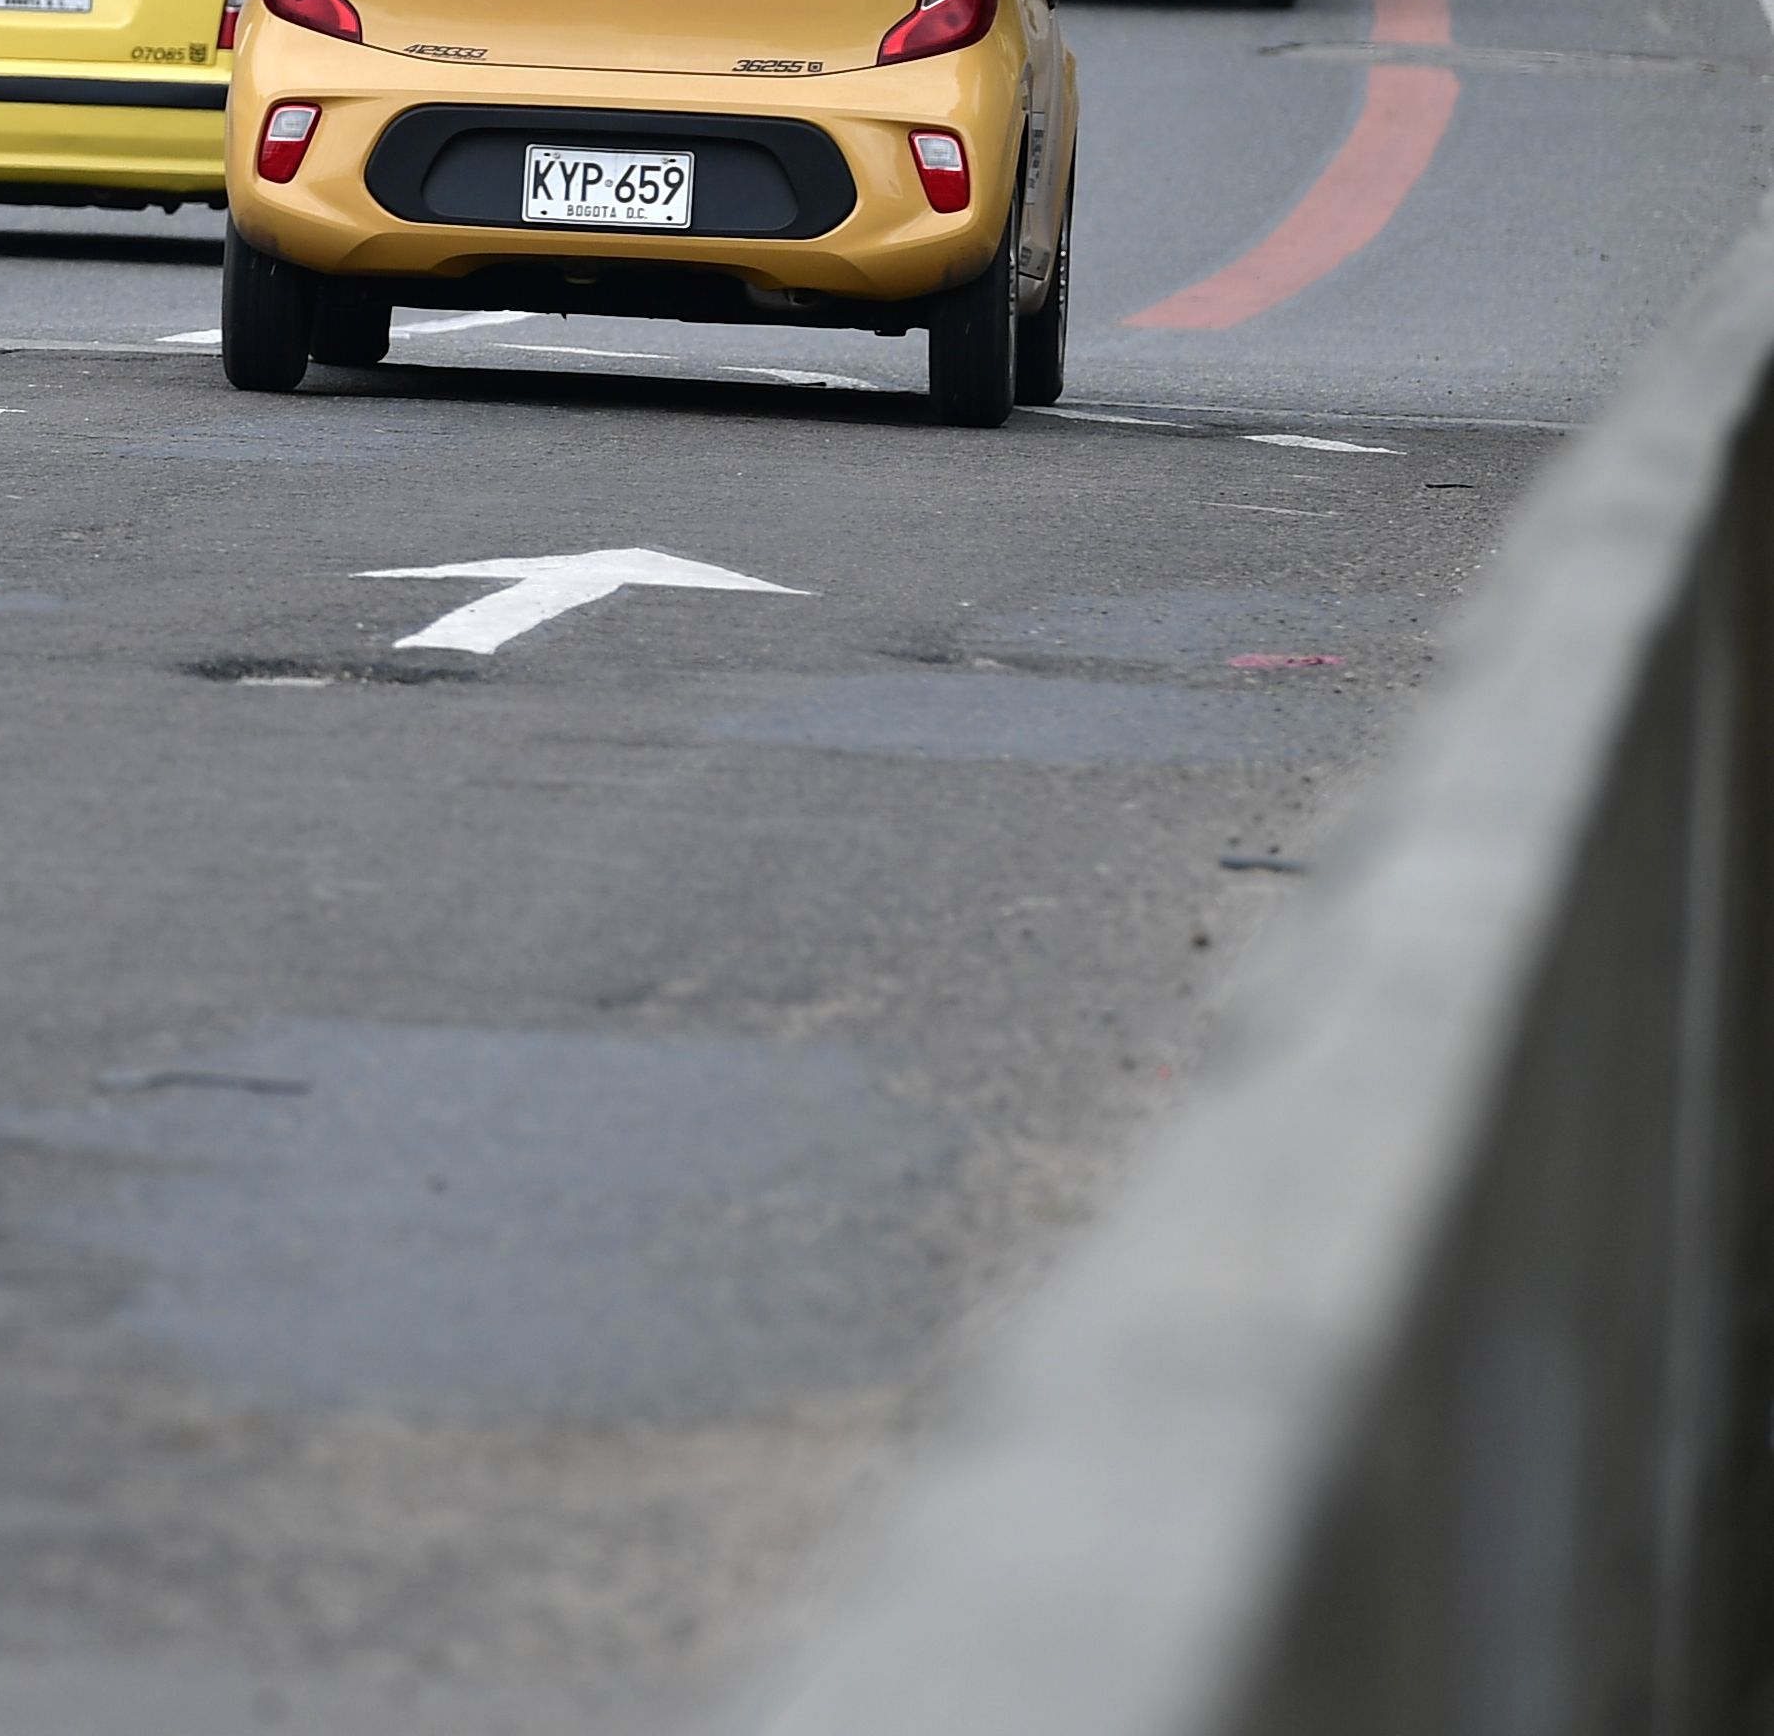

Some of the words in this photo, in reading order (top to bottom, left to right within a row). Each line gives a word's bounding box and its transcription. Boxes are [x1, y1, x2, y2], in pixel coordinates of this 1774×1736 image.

[131, 45, 186, 61] 07085
[402, 43, 489, 59] 4129333
[731, 59, 803, 74] 36255
[566, 204, 617, 219] BOGOTA
[626, 207, 648, 220] D.C.
